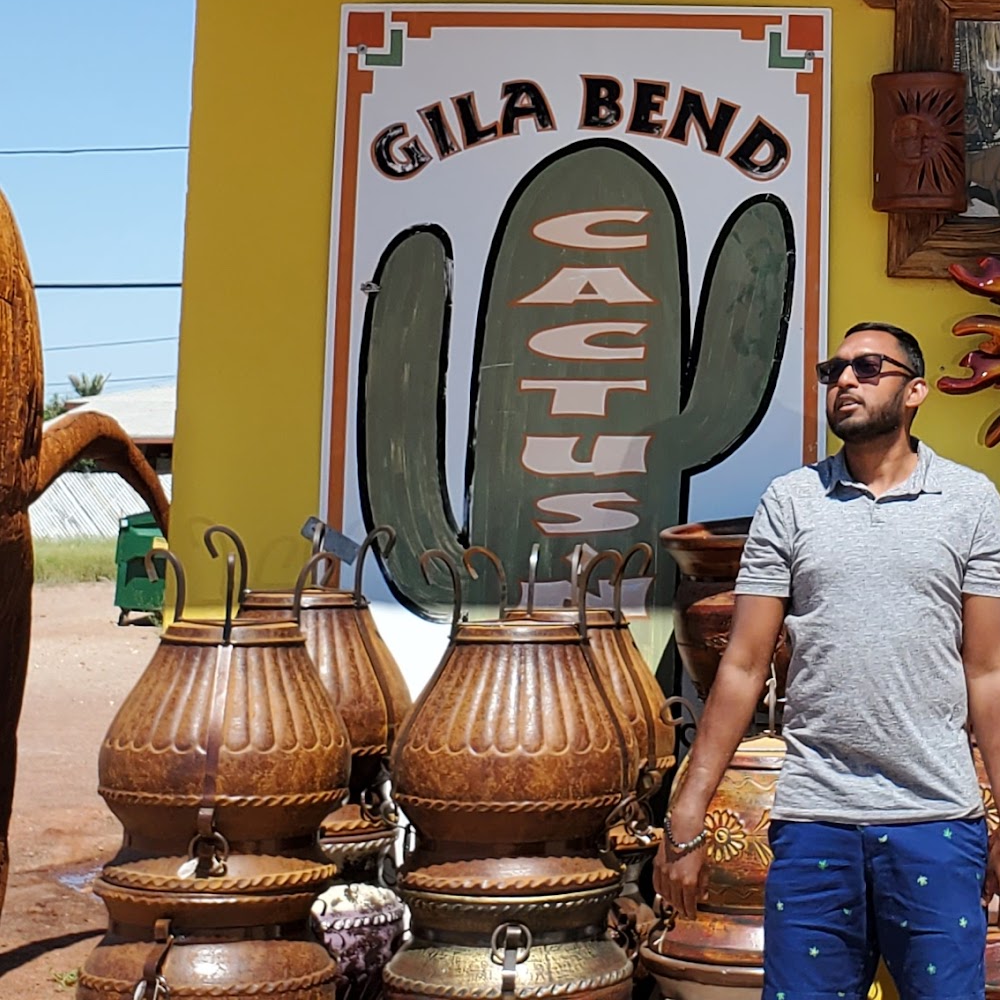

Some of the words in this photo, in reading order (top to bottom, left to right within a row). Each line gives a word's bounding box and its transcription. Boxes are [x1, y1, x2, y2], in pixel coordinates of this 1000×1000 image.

[371, 79, 557, 181] GILA
[578, 74, 791, 182] BEND
[514, 209, 656, 535] CACTUS
